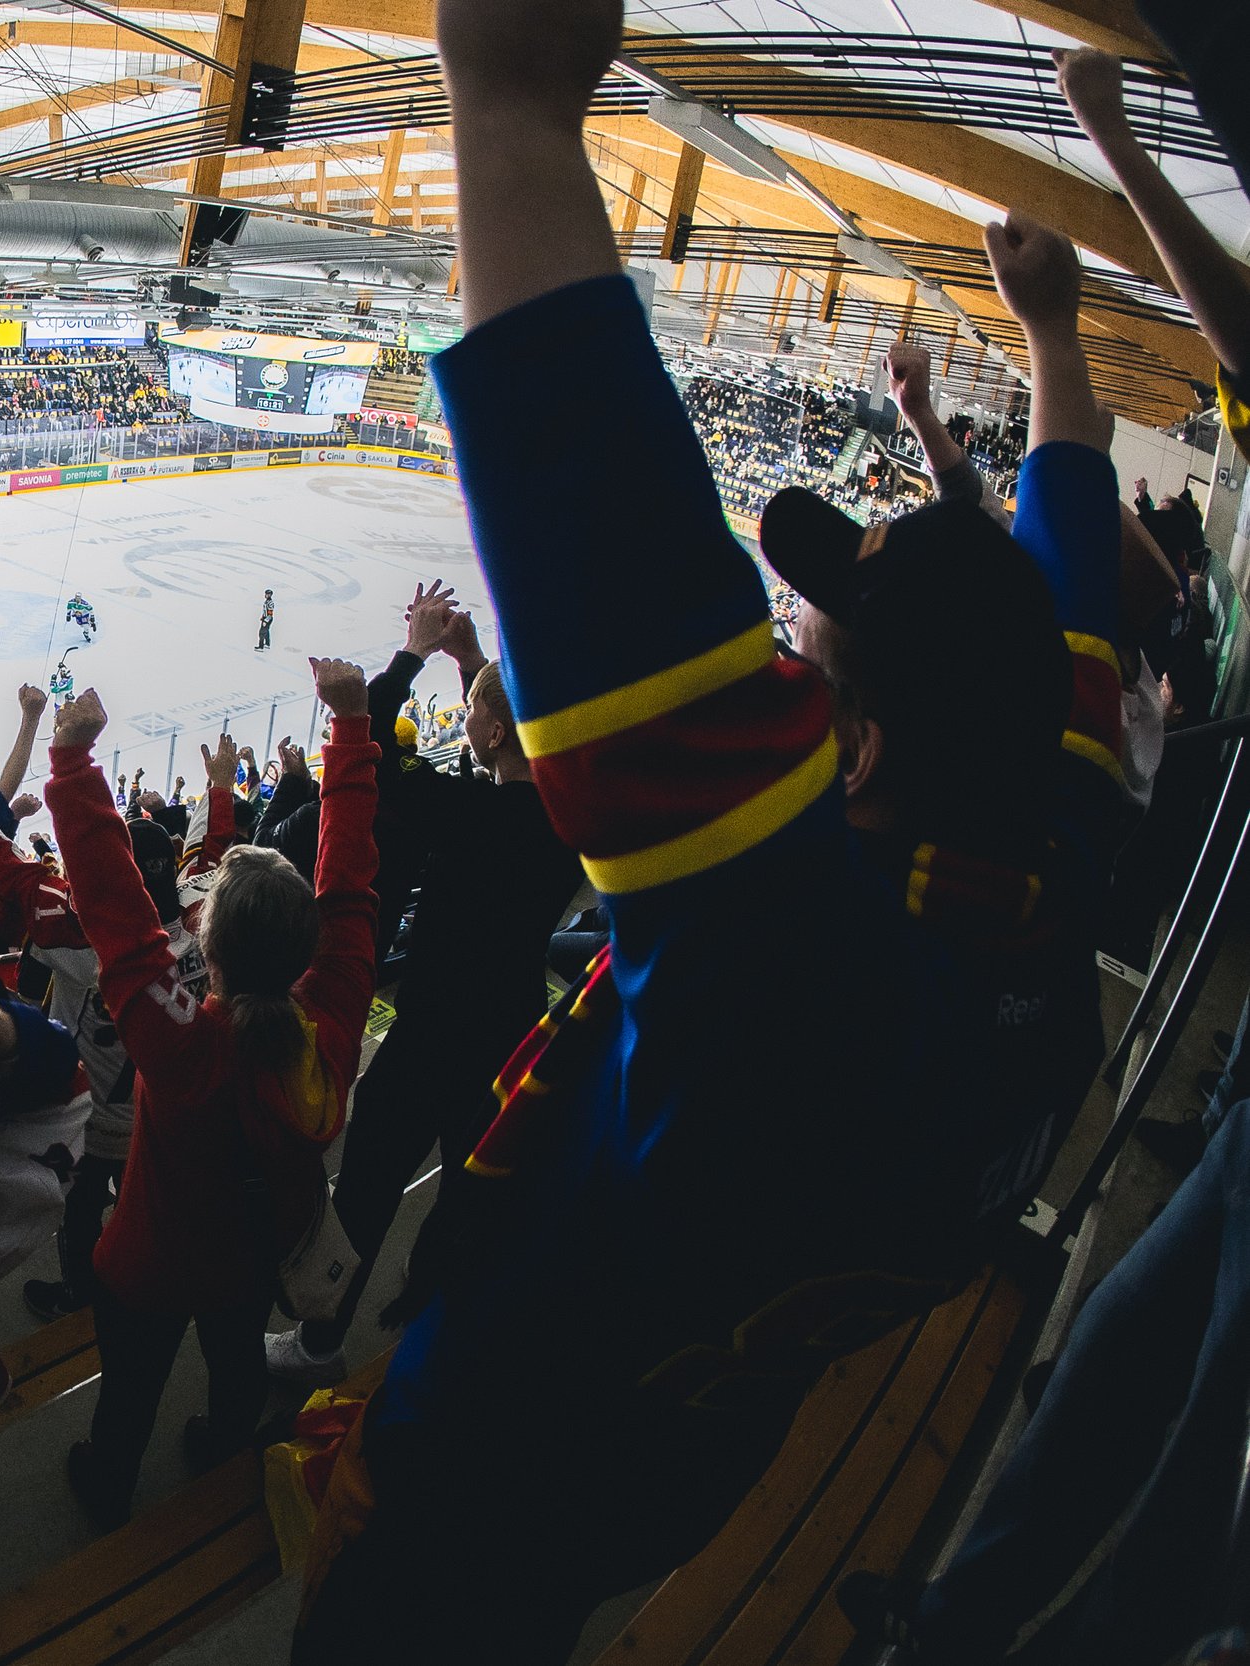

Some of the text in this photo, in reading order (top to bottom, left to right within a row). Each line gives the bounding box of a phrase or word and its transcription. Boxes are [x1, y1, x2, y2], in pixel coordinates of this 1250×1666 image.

[326, 452, 345, 461] Cinia
[367, 455, 393, 464] SAKELA
[18, 474, 53, 487] SAVONIA
[65, 470, 103, 481] premetec
